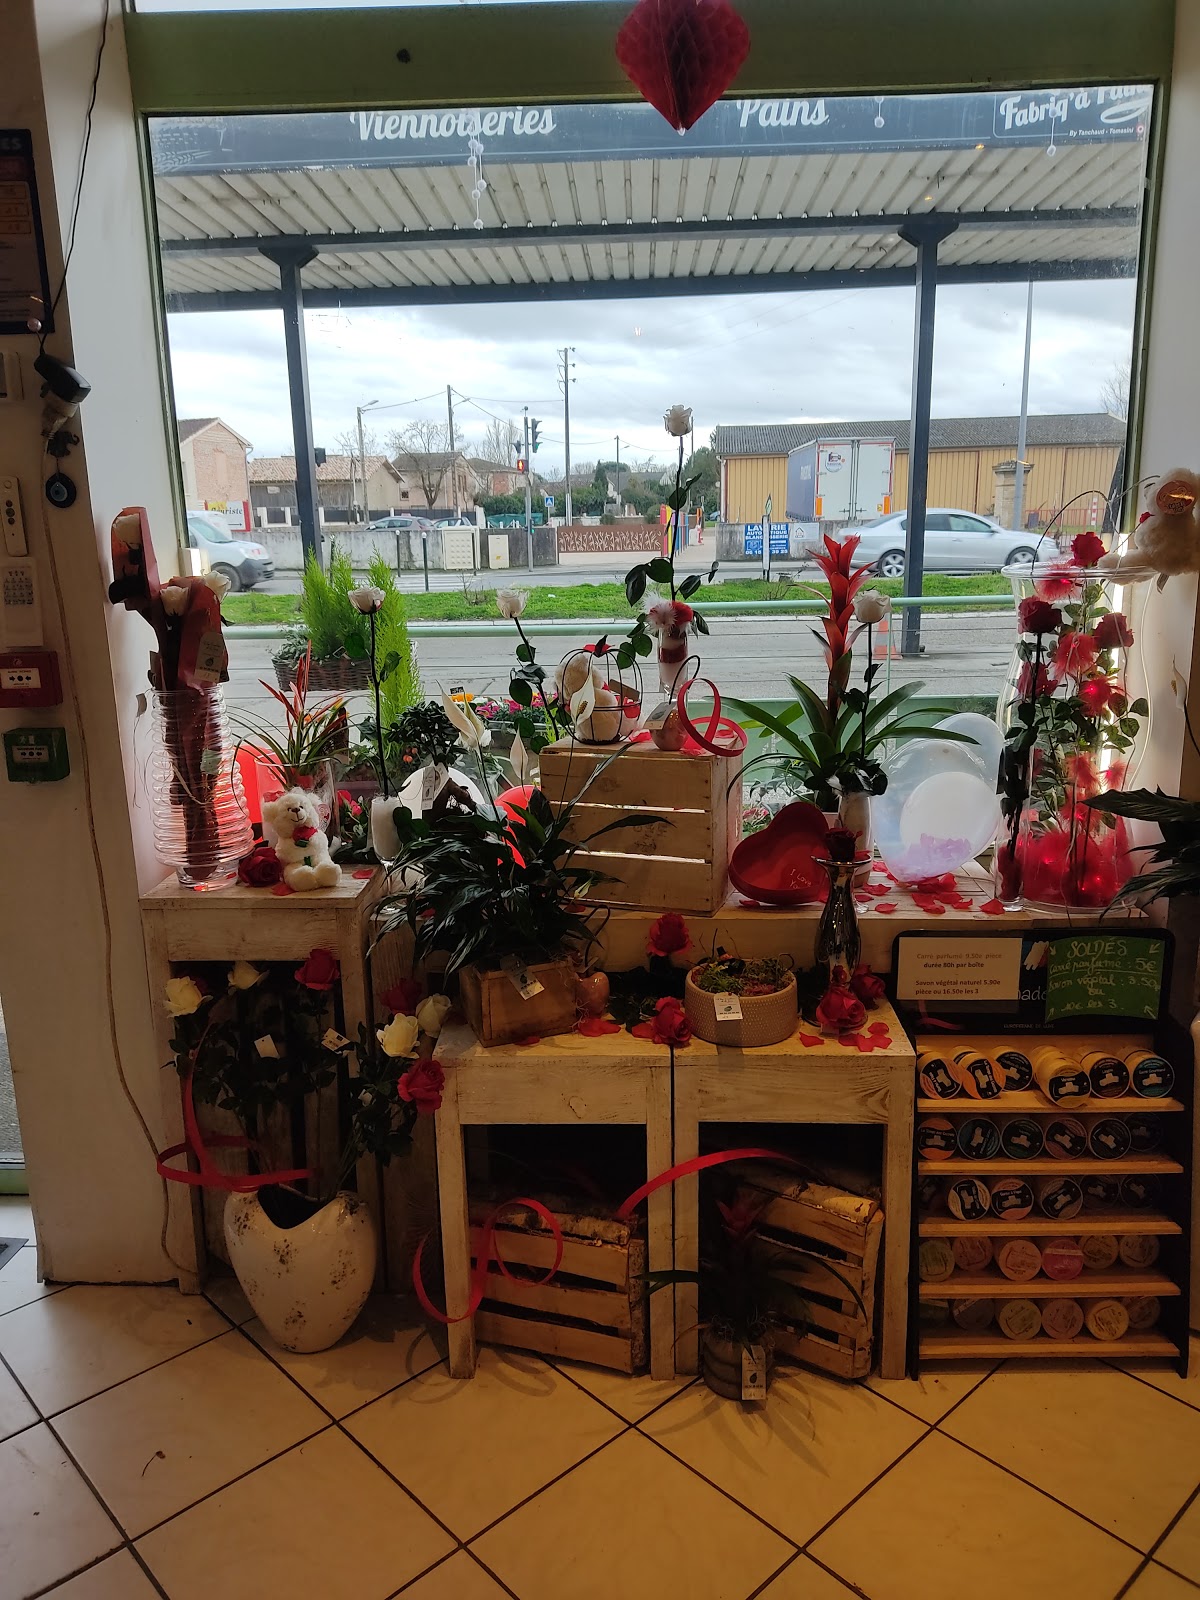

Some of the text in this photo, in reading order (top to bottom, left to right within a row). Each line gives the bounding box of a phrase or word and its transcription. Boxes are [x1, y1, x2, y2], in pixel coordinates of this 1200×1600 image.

[350, 106, 556, 141] Viennoiseries
[736, 98, 829, 128] Pains
[1069, 130, 1078, 138] By
